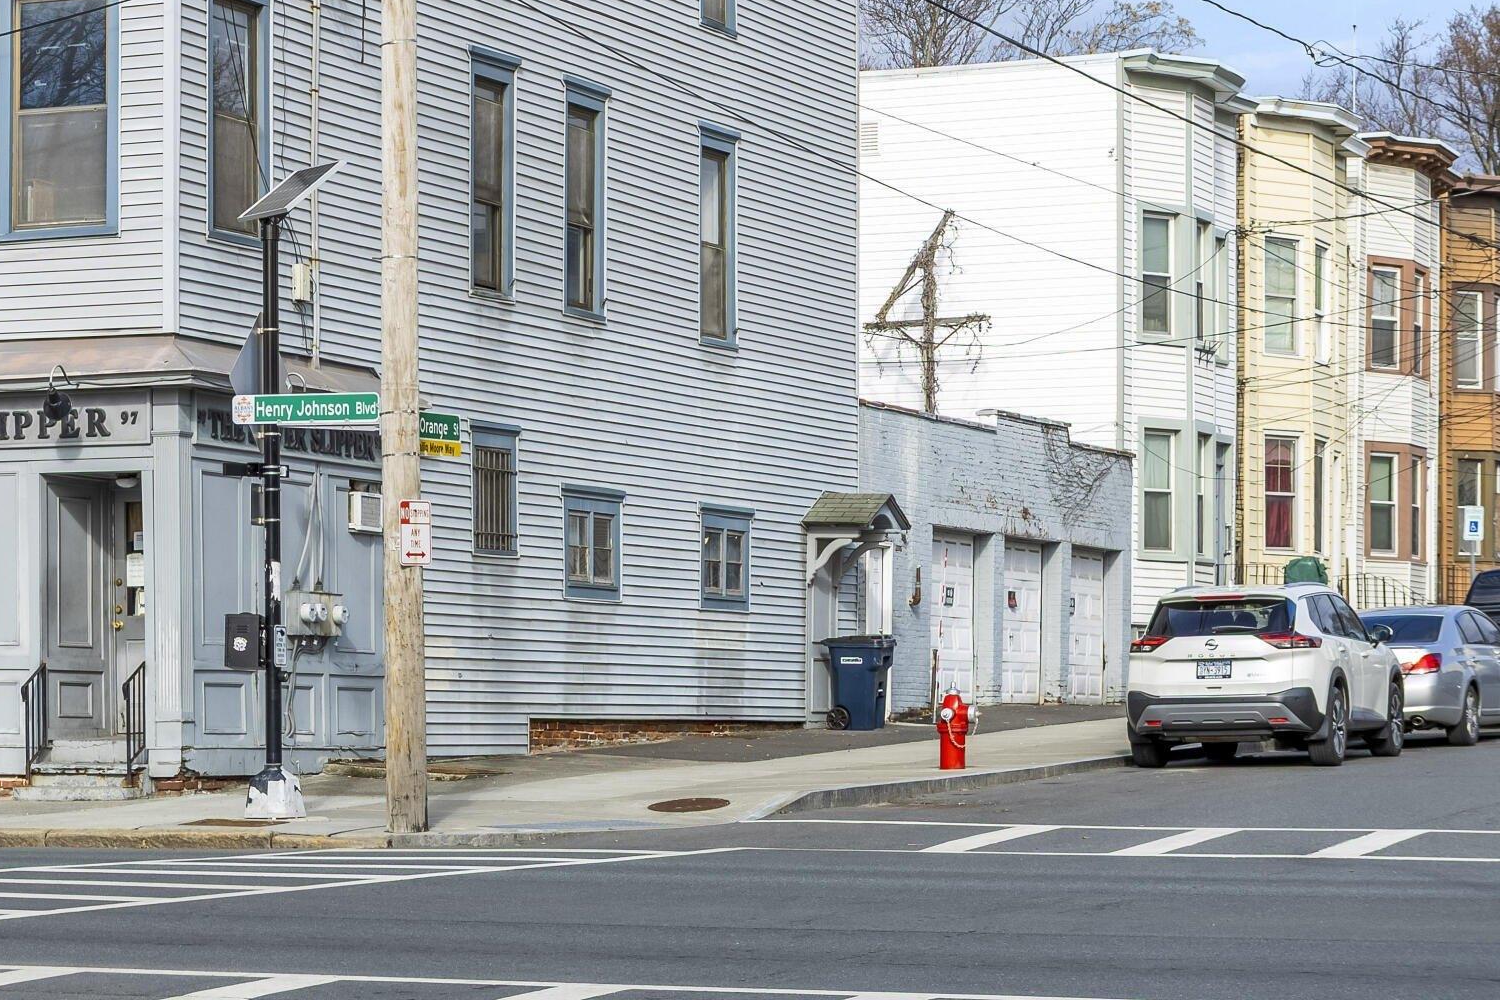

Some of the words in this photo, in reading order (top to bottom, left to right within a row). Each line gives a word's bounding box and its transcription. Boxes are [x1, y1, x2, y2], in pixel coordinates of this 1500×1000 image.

[256, 401, 293, 420] Henry
[296, 400, 350, 417] Johnson
[355, 401, 376, 415] Blvd
[420, 417, 448, 439] Orange
[453, 422, 459, 436] St
[445, 444, 455, 456] Way
[400, 507, 410, 520] NO
[410, 509, 429, 519] STOPPING
[411, 529, 420, 537] ANY
[411, 540, 421, 549] TIME
